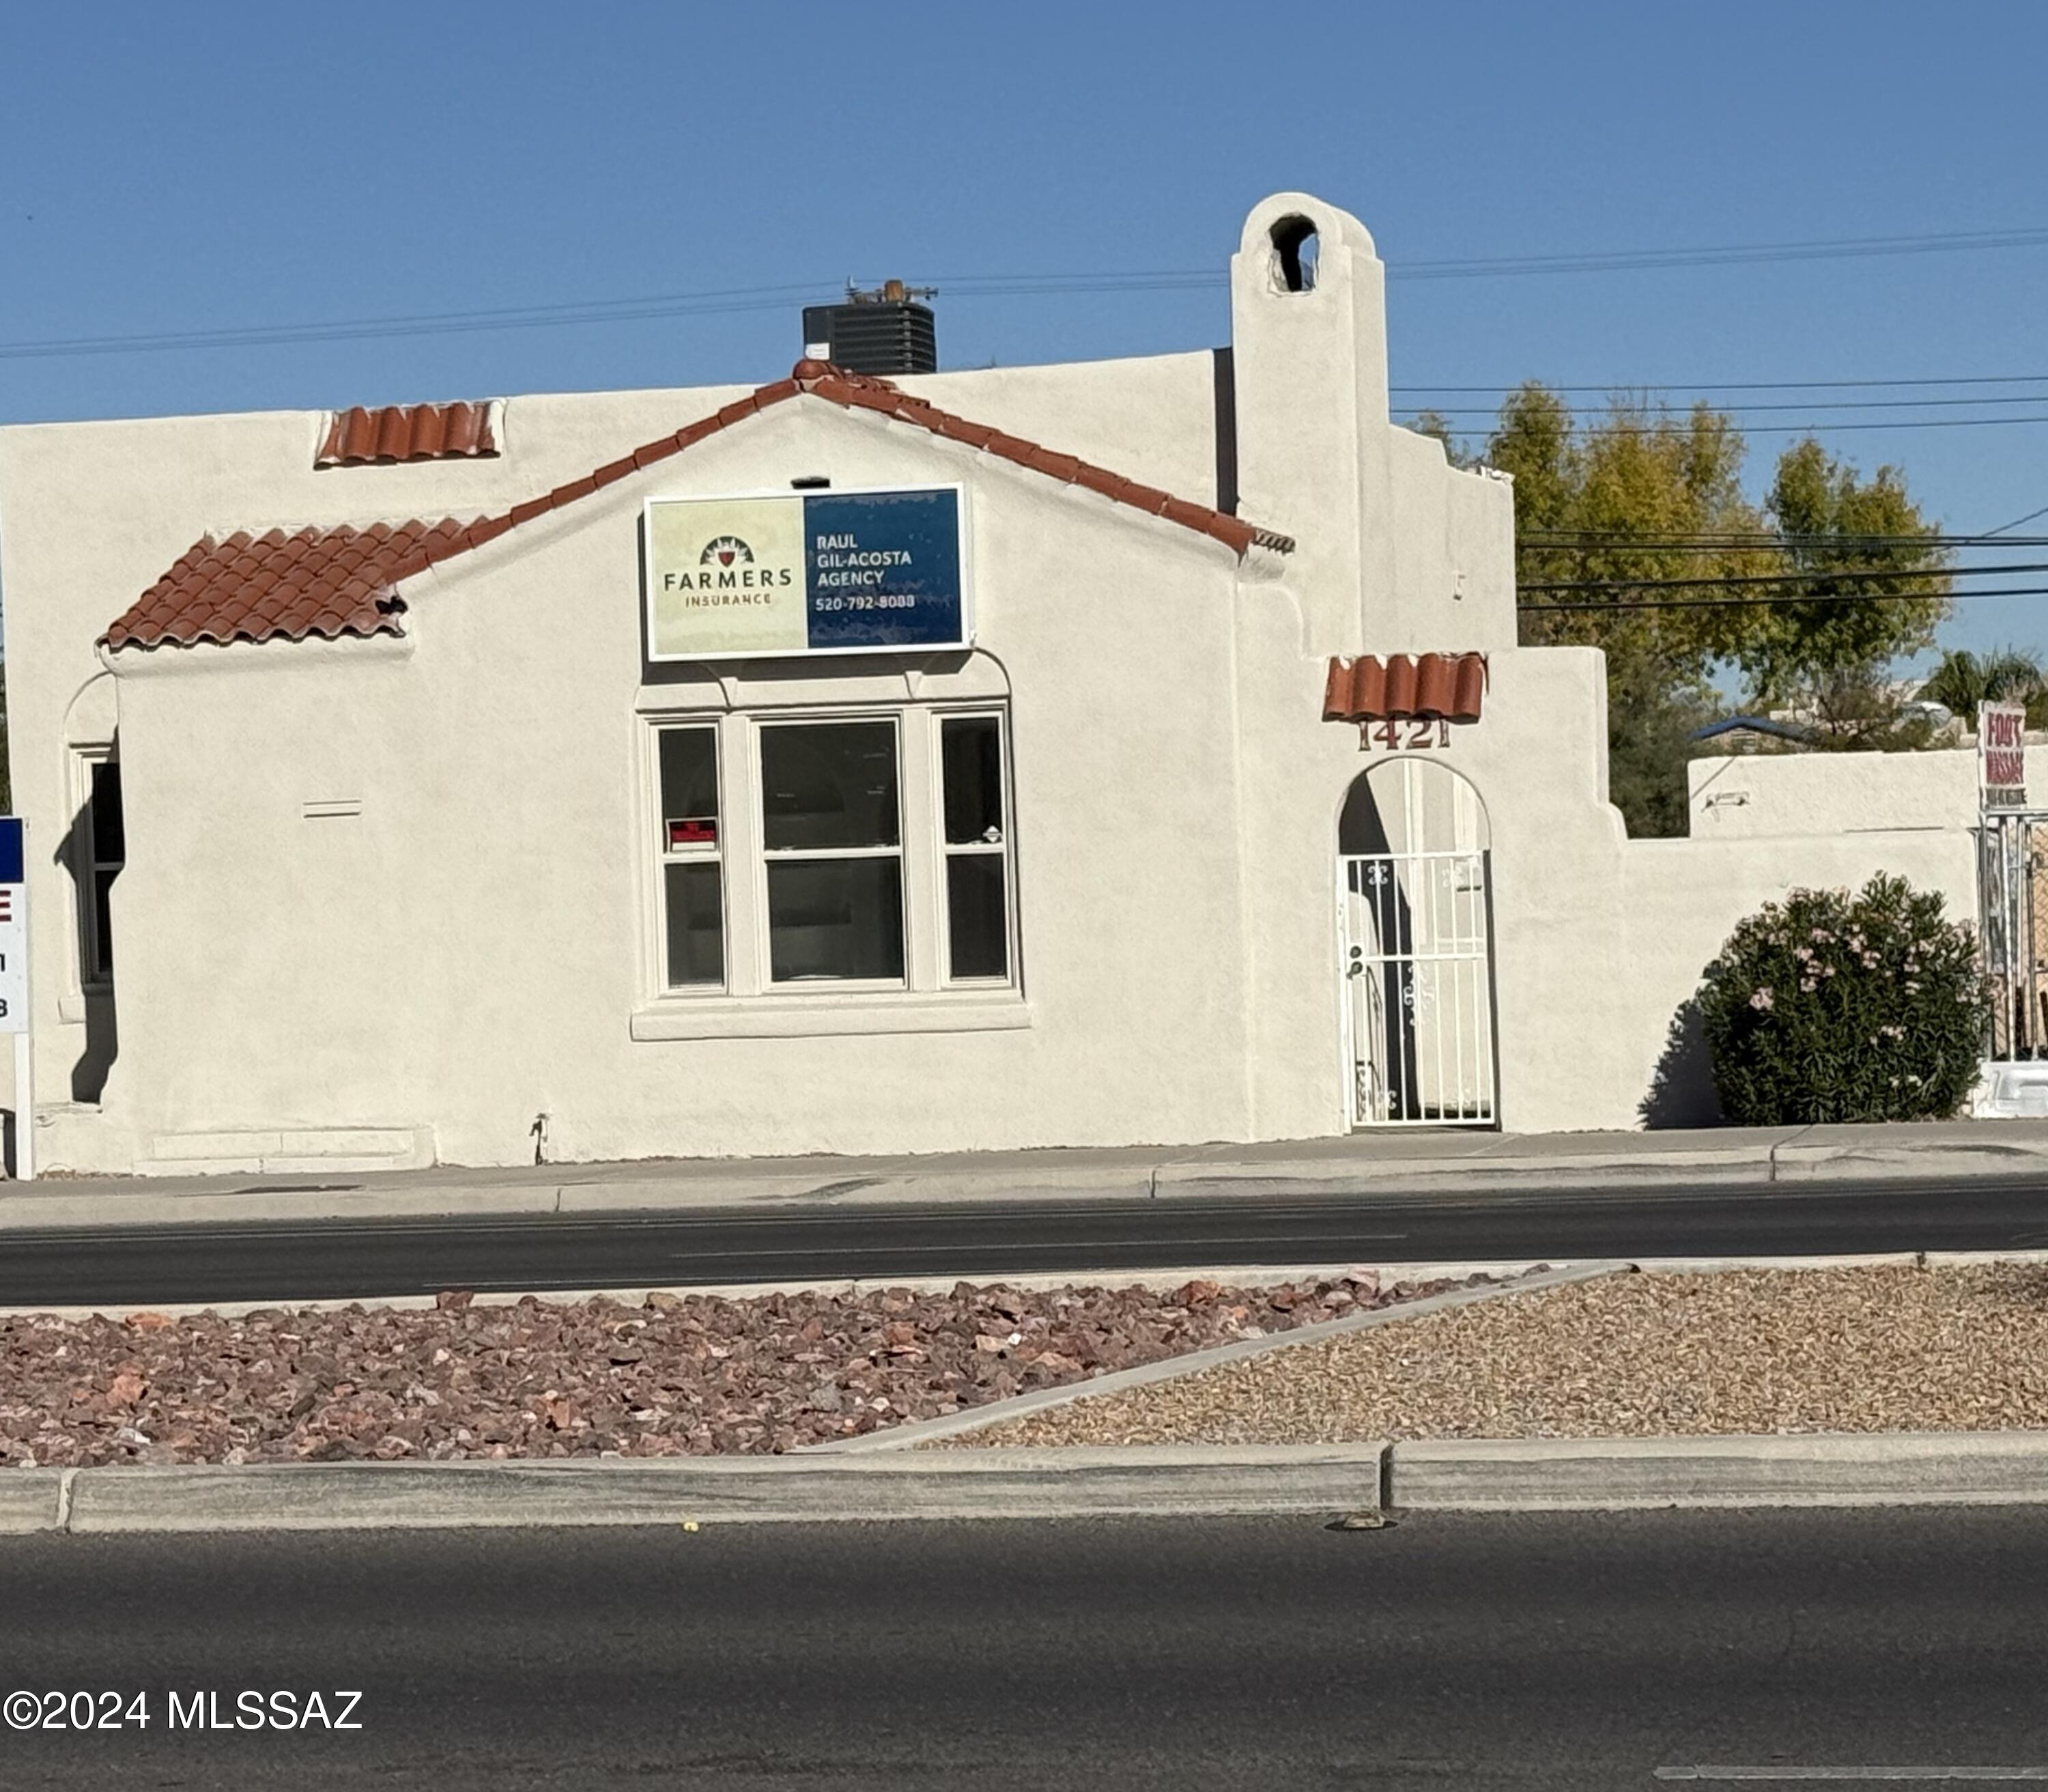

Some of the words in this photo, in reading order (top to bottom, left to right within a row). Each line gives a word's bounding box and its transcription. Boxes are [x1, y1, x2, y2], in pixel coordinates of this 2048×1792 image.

[816, 533, 858, 550] RAUL
[817, 550, 913, 569] GIL-ACOSTA
[664, 568, 792, 591] FARMERS
[817, 569, 885, 587] AGENCY
[685, 593, 772, 608] INSURANCE
[1359, 717, 1450, 752] 1421
[1987, 712, 2023, 747] FOOT
